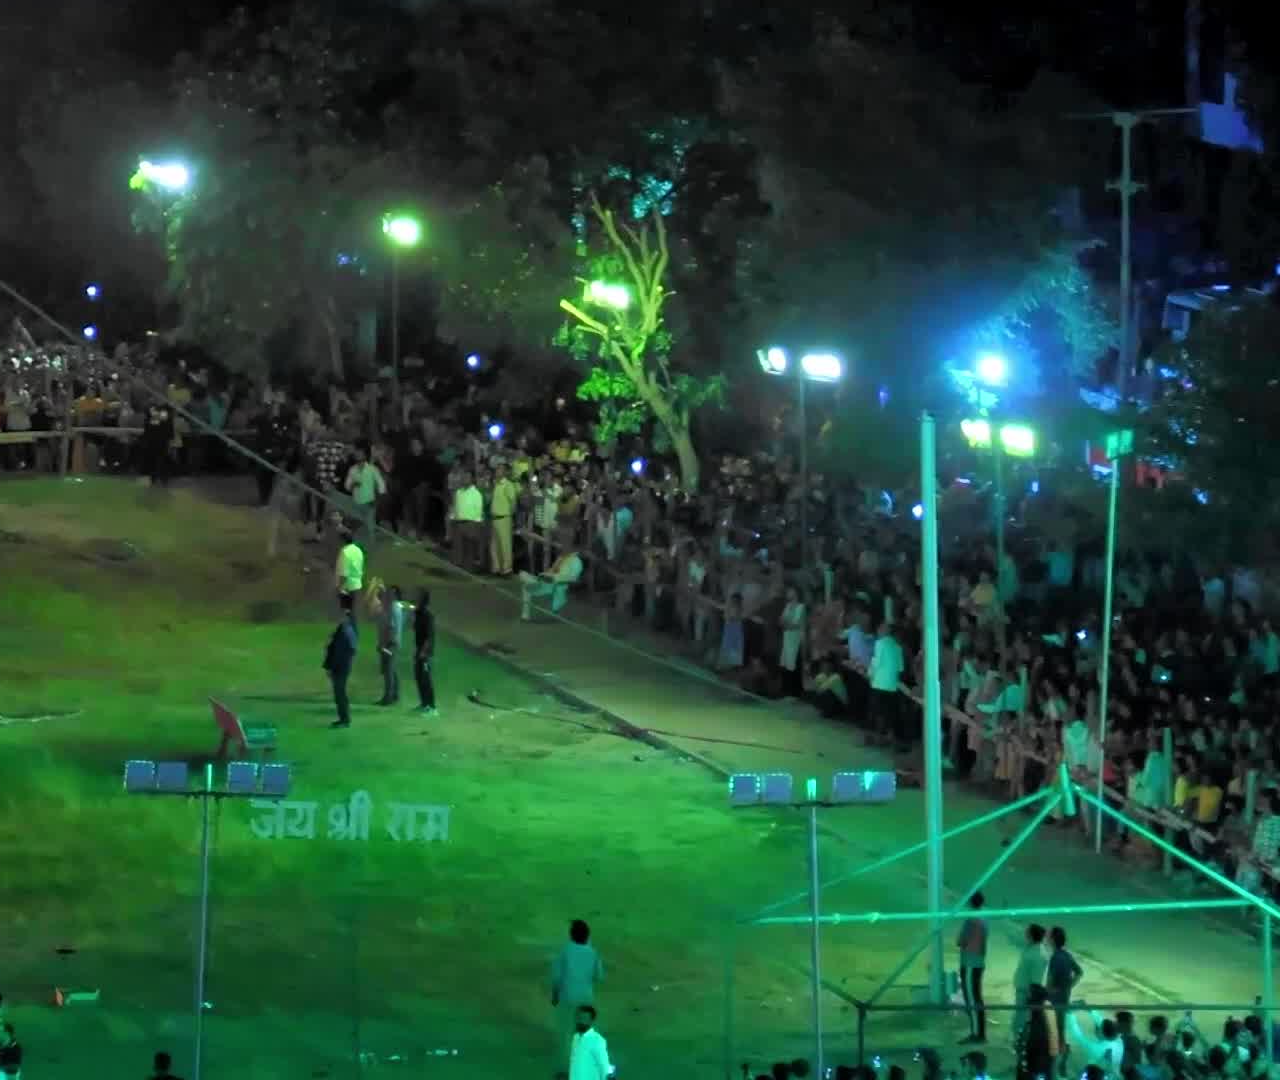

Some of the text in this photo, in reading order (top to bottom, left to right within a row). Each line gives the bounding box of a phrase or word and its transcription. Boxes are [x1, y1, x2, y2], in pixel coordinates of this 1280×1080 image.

[249, 789, 450, 841] जय श्री राम
